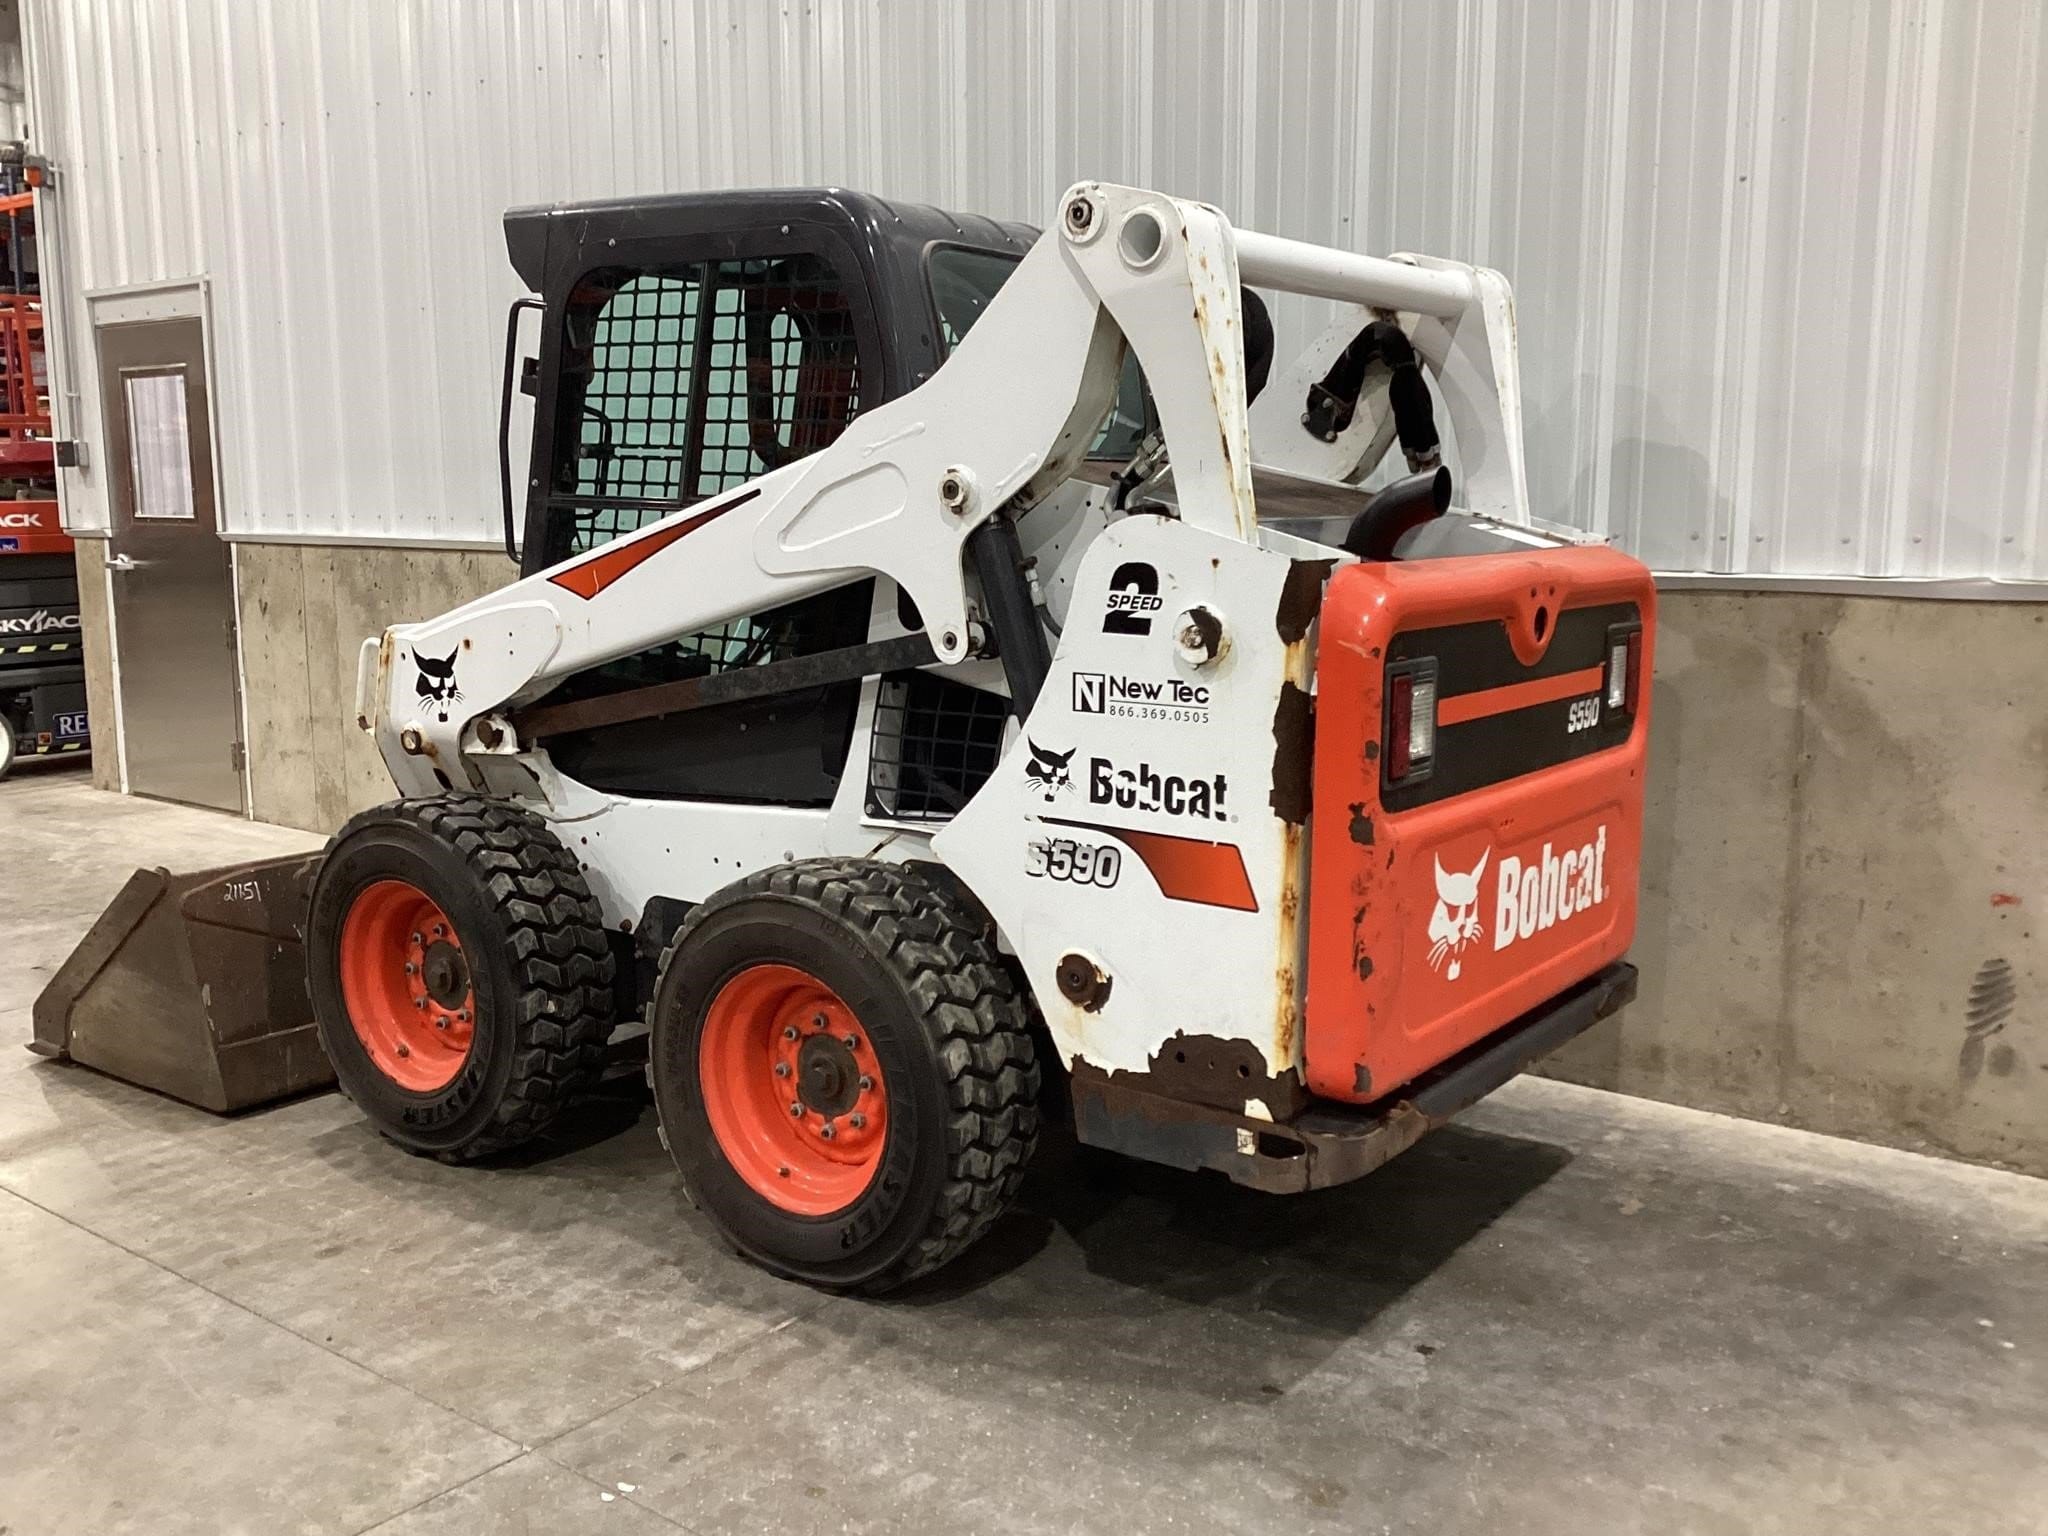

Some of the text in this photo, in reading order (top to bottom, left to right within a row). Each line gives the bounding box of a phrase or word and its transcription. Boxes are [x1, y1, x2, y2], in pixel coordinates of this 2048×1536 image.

[1102, 562, 1159, 636] 2
[1106, 594, 1163, 611] SPEED
[1109, 676, 1210, 704] New Tec
[1109, 705, 1209, 724] 866.369.0505
[1567, 697, 1600, 734] S590
[1089, 757, 1227, 822] Bobcat
[1025, 837, 1122, 889] S590
[1494, 825, 1607, 951] Bobcat
